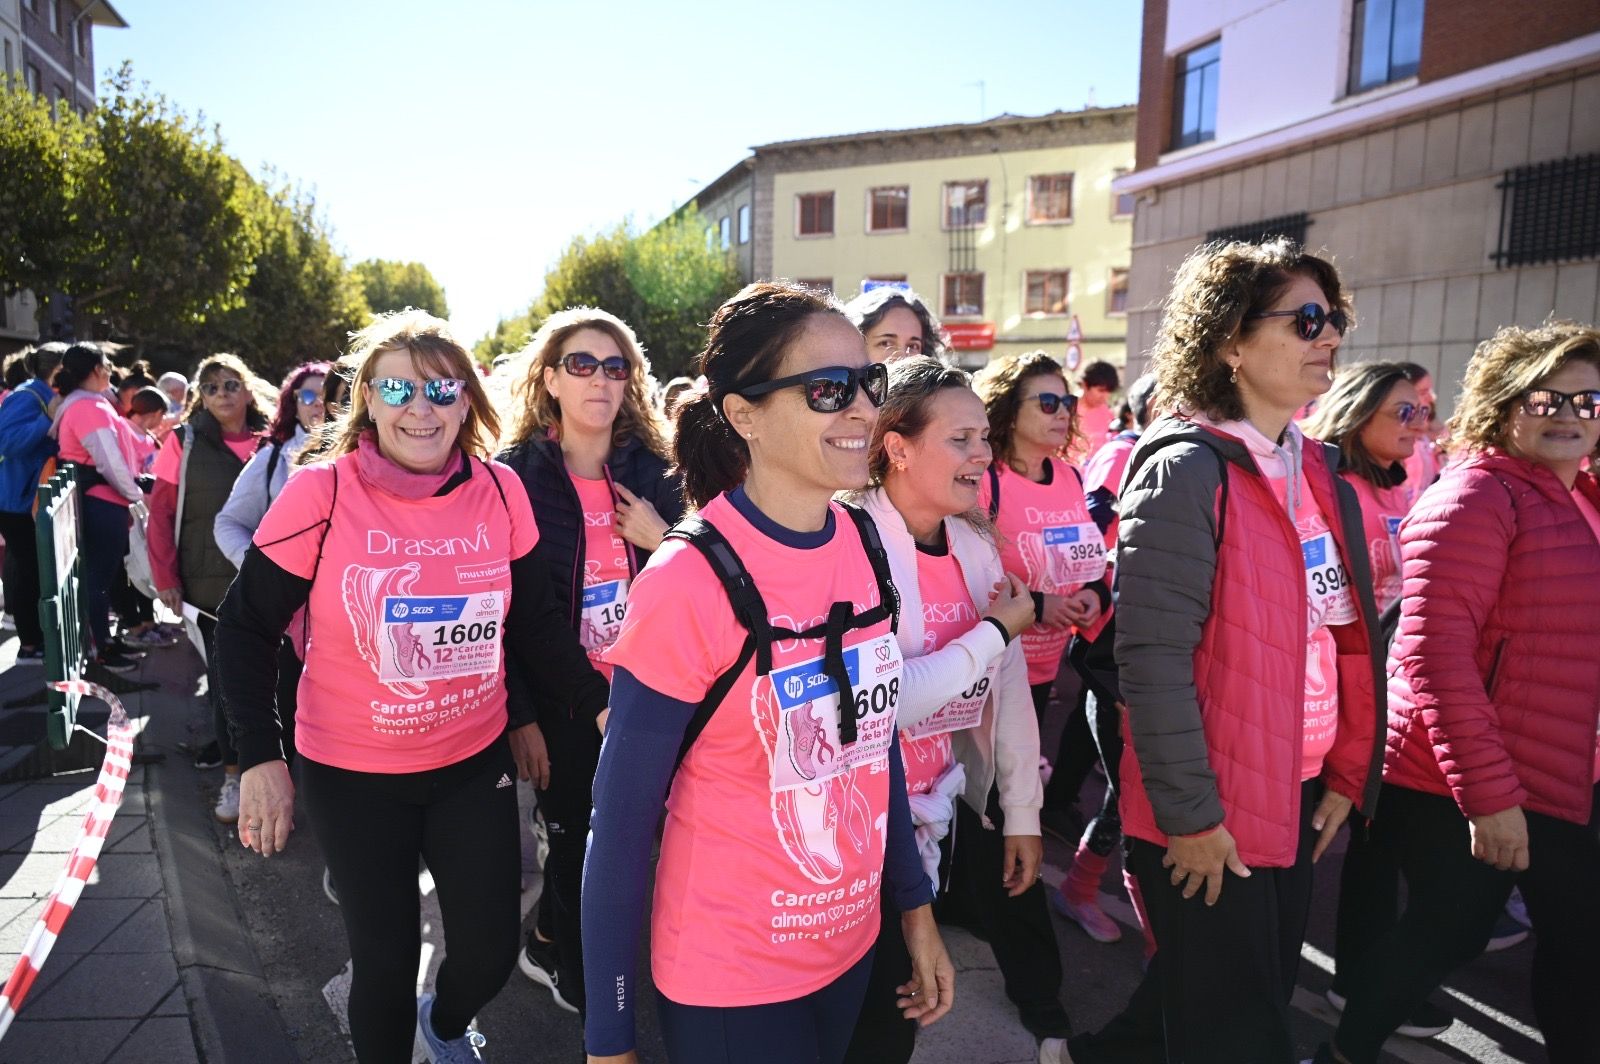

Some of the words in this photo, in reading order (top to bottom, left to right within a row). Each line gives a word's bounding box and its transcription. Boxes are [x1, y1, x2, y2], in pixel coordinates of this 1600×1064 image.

[1024, 502, 1085, 525] Drasanvi
[367, 521, 491, 556] Drasanvi
[1070, 542, 1104, 561] 3924
[475, 608, 500, 617] almom
[601, 601, 628, 626] 16
[432, 620, 497, 647] 1606
[458, 643, 495, 653] Carrera
[458, 653, 467, 661] de
[467, 652, 475, 660] la
[475, 650, 495, 659] Mujer
[875, 658, 900, 674] almom
[784, 675, 804, 699] hp
[371, 700, 435, 715] Carrera
[440, 693, 459, 706] de
[463, 688, 475, 700] la
[838, 676, 899, 728] 608
[372, 714, 419, 727] almom
[862, 733, 873, 742] de
[874, 730, 882, 739] la
[771, 887, 845, 907] Carrera
[850, 878, 867, 897] de
[869, 871, 879, 888] la
[771, 911, 827, 929] almom
[771, 931, 820, 944] contra
[824, 927, 836, 939] el
[616, 974, 625, 1011] WEDZE
